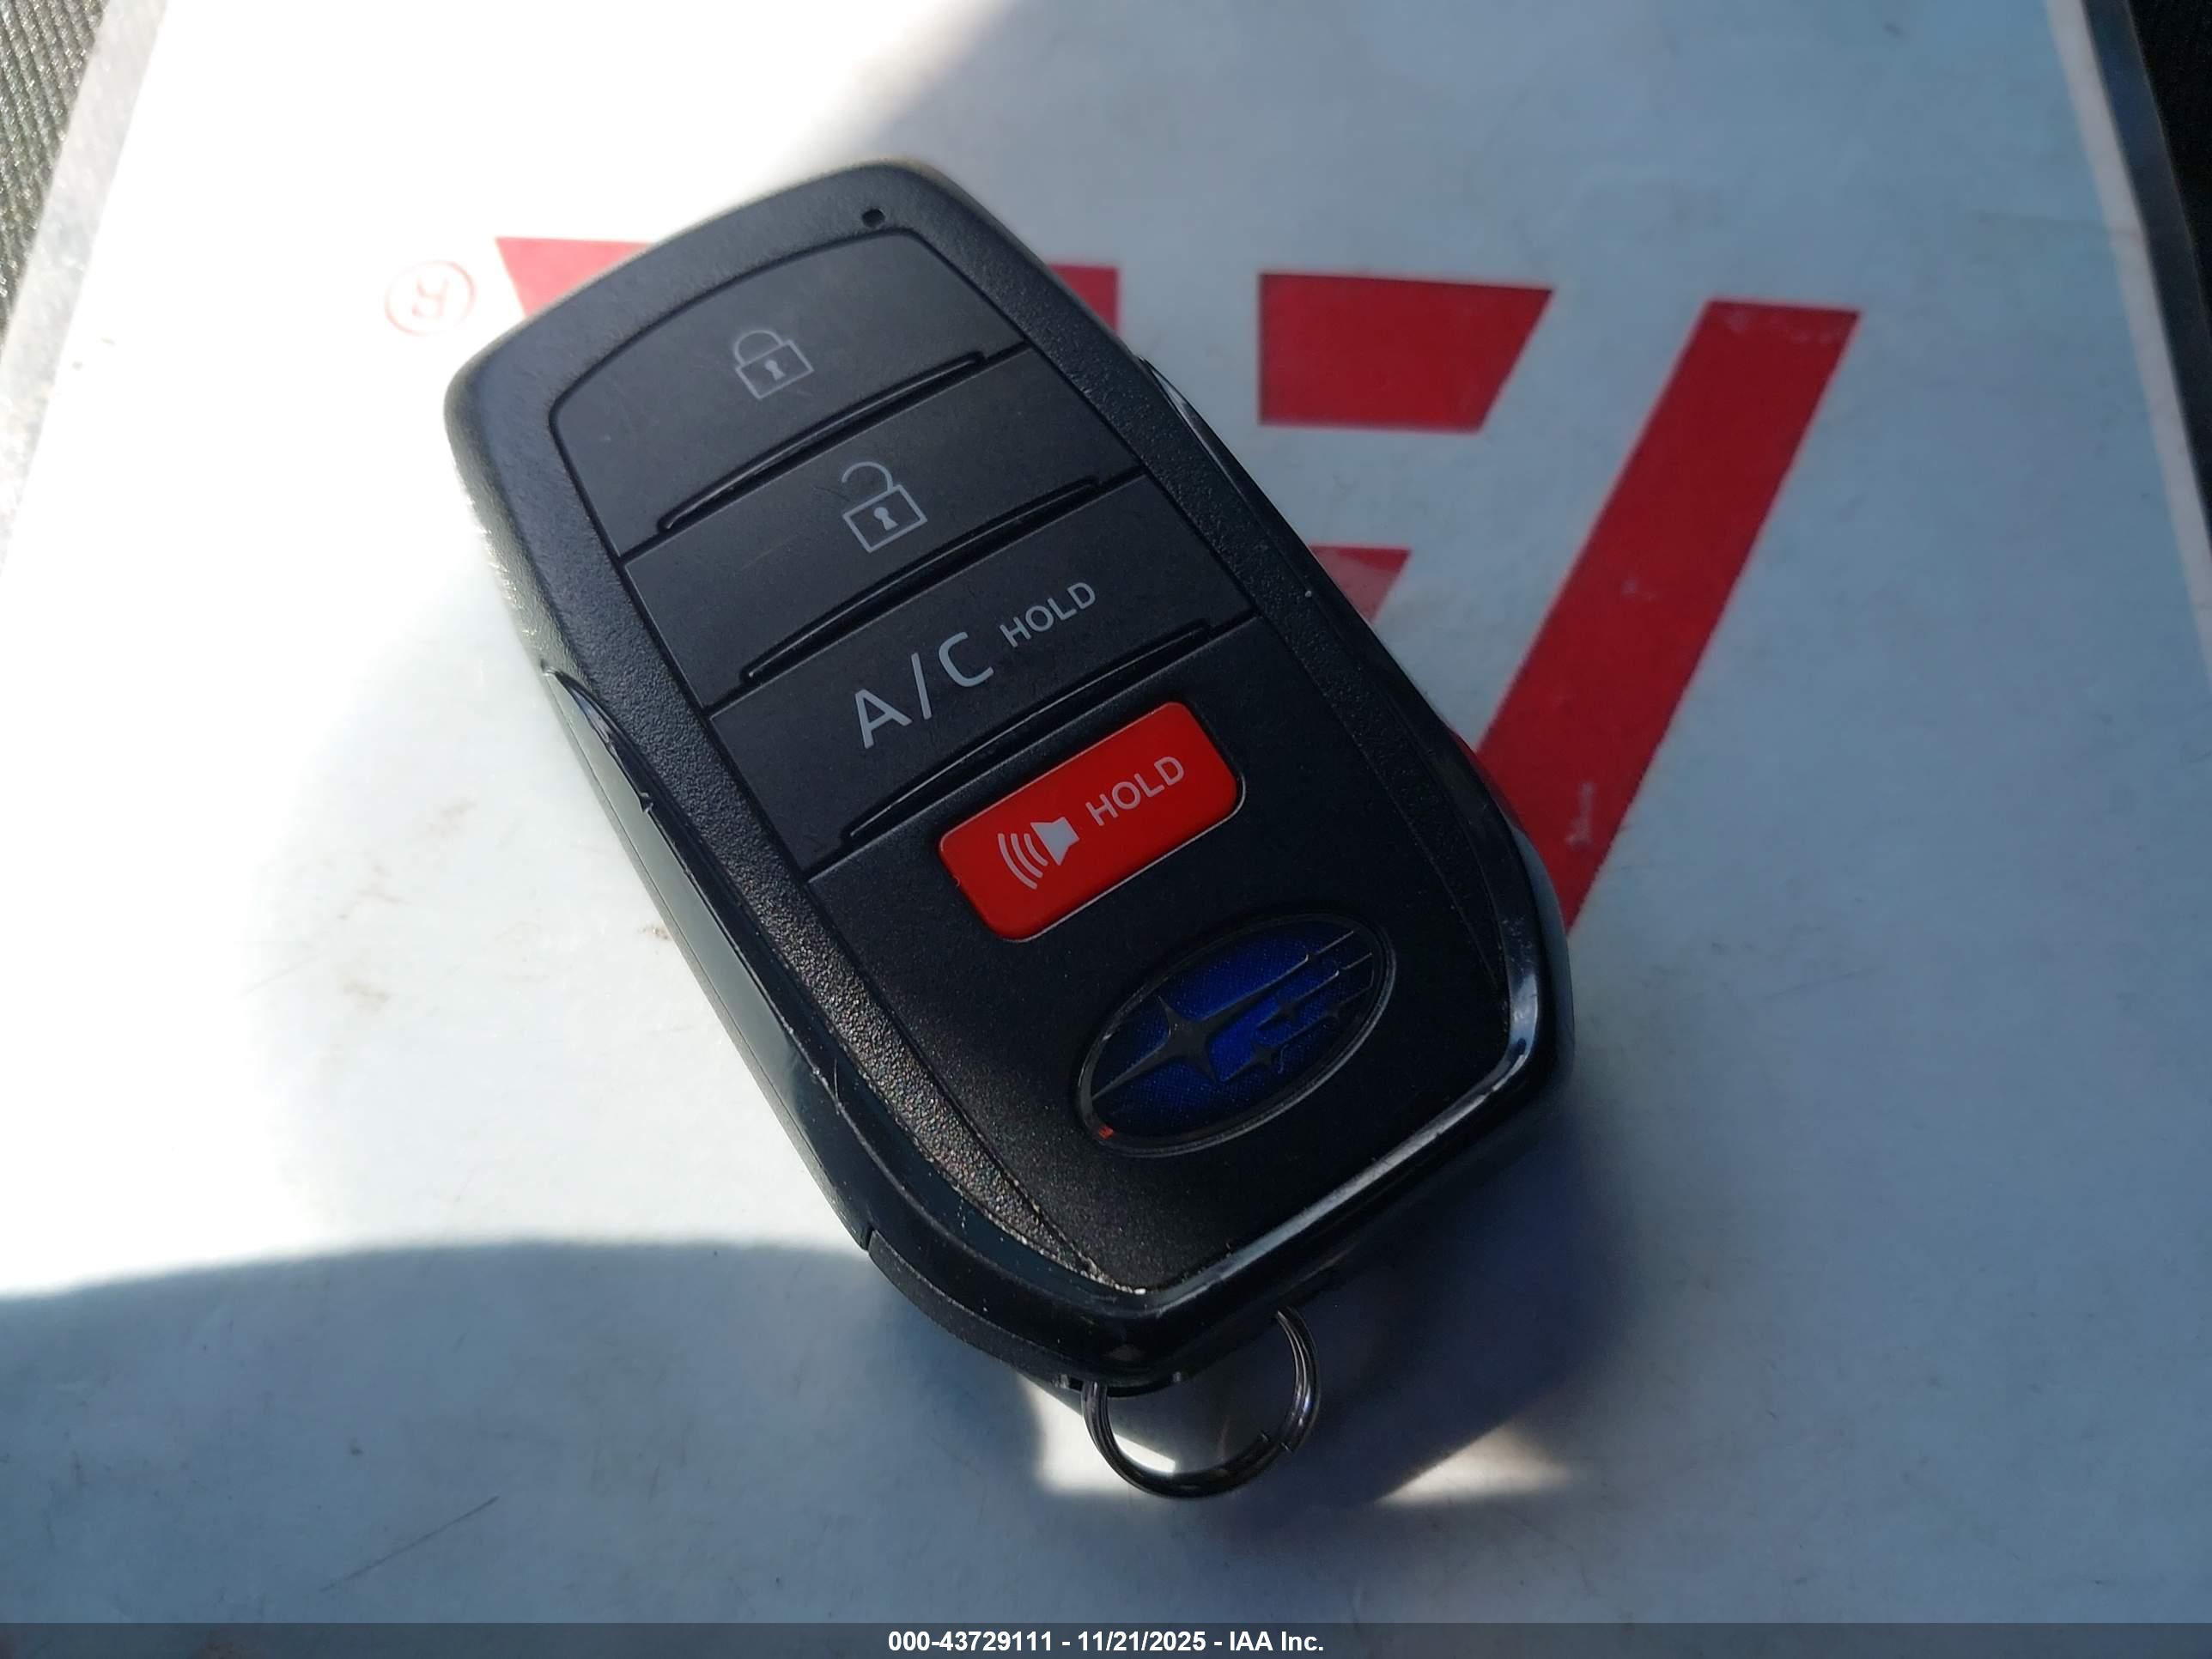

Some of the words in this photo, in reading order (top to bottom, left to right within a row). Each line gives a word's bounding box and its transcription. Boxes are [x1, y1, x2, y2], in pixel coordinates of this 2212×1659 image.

[854, 631, 994, 750] A/C
[999, 581, 1097, 648] HOLD
[1085, 756, 1185, 826] HOLD
